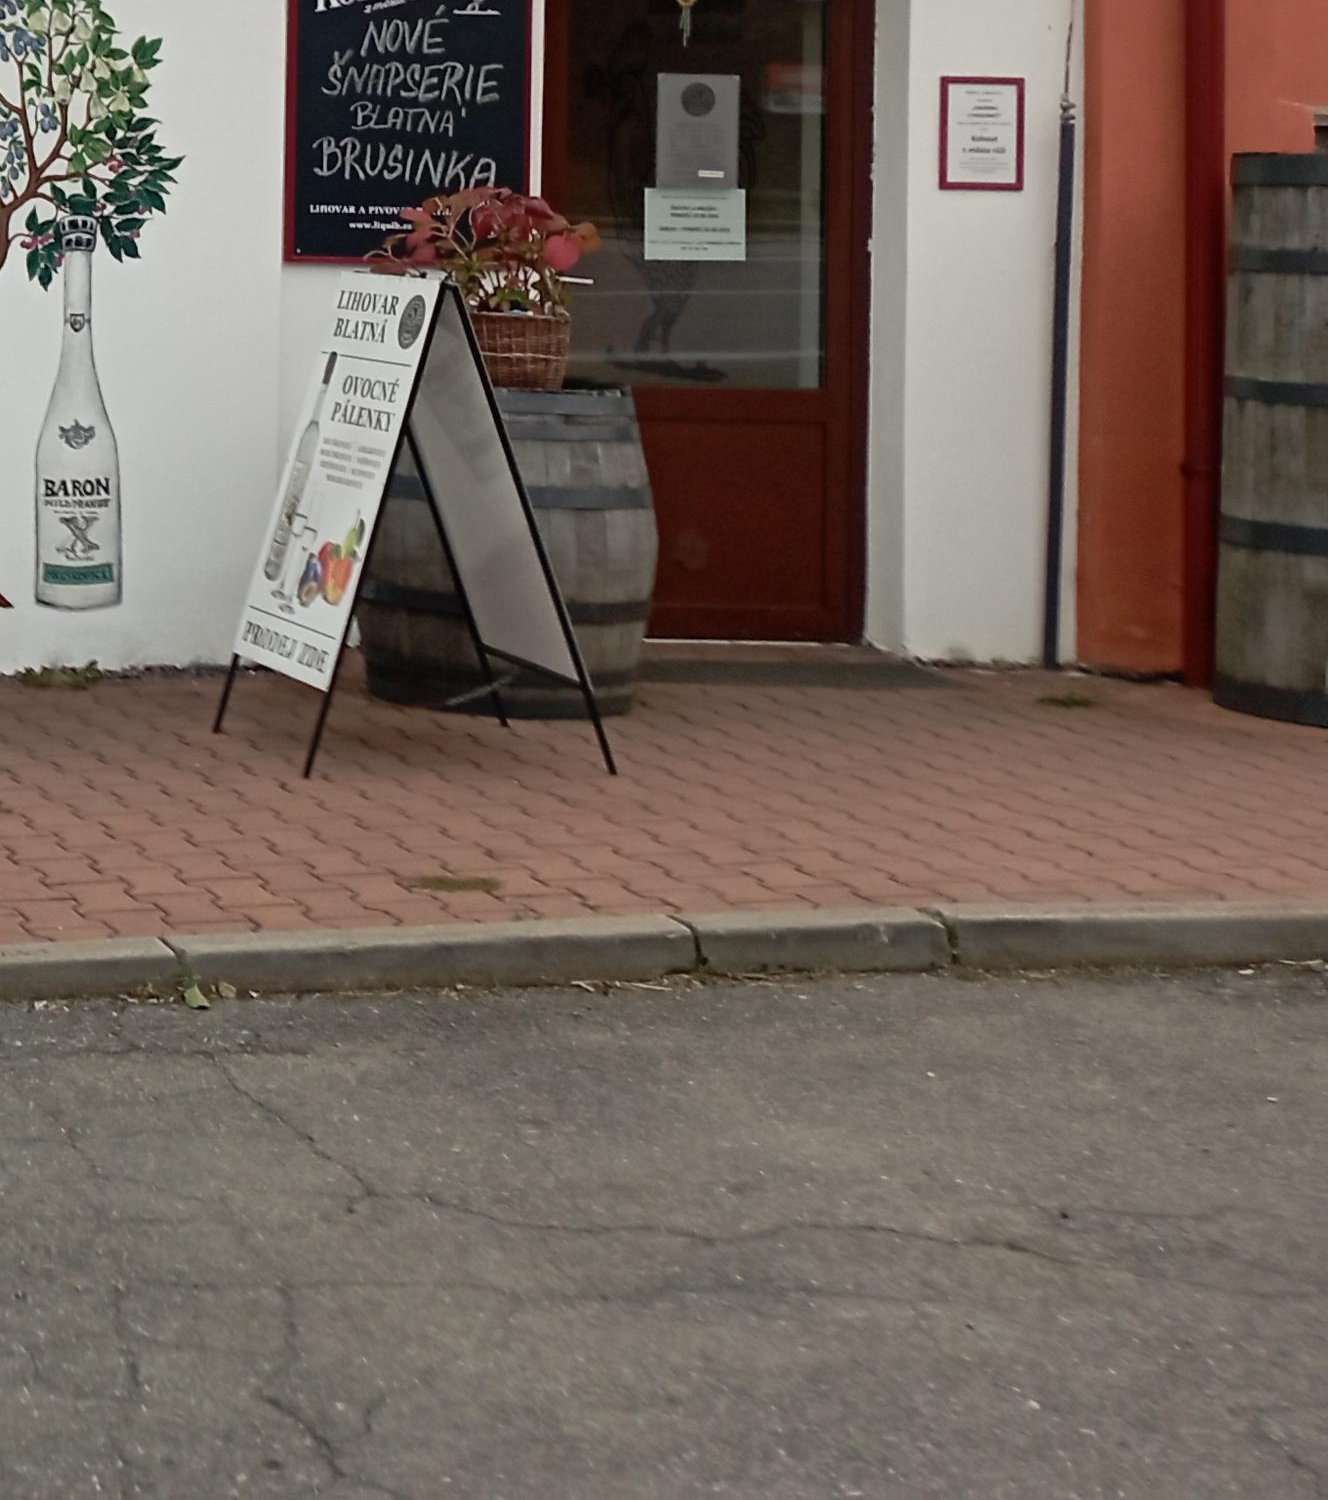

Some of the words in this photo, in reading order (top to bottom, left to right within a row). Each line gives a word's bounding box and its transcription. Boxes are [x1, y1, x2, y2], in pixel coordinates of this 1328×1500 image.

[360, 4, 450, 57] NOVÉ
[320, 50, 504, 106] ŠNAPSERIE
[350, 101, 467, 138] BLATNÁ
[311, 135, 497, 191] BRUSINKA
[336, 289, 400, 317] LIHOVAR
[333, 317, 389, 344] BLATNÁ
[341, 374, 400, 404] OVOCNÉ
[330, 398, 396, 433] PÁLENKY
[43, 477, 111, 498] BARON
